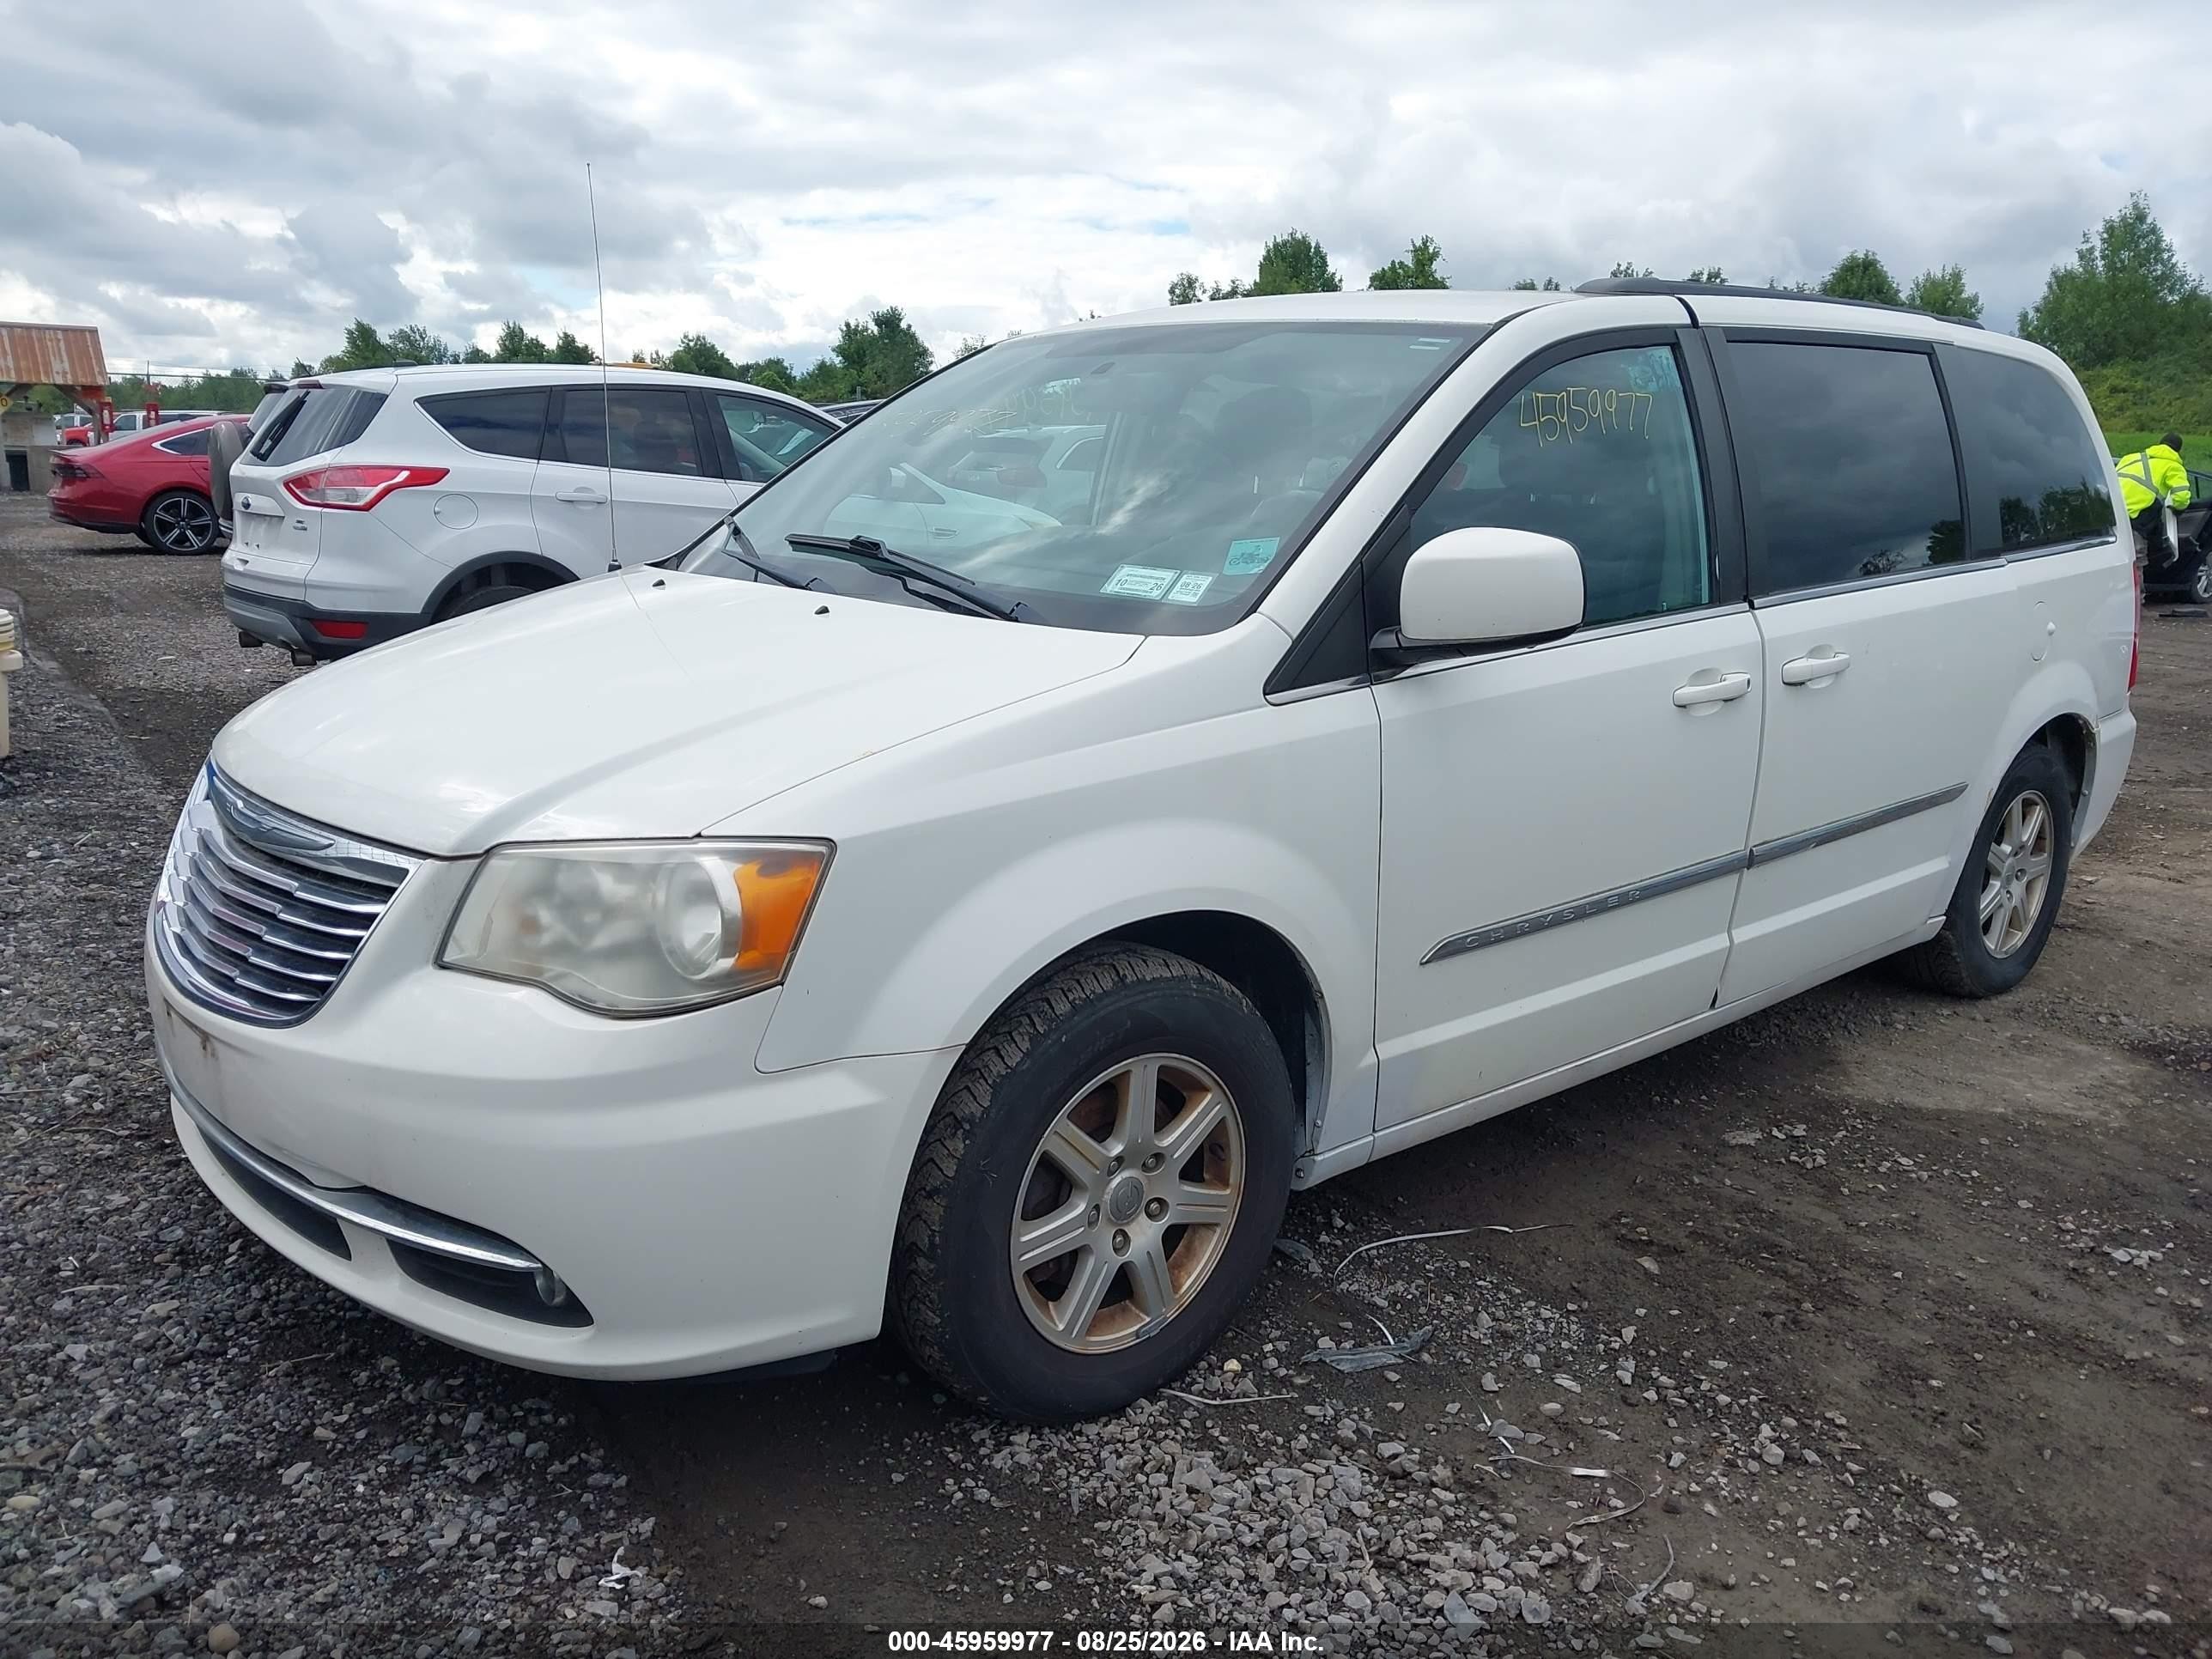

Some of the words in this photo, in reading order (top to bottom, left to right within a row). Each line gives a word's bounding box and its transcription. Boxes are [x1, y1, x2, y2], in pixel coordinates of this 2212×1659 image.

[1519, 387, 1653, 447] 45959977
[1115, 578, 1128, 586] 10
[1149, 582, 1164, 591] 26
[1464, 889, 1642, 948] CHRYSLER
